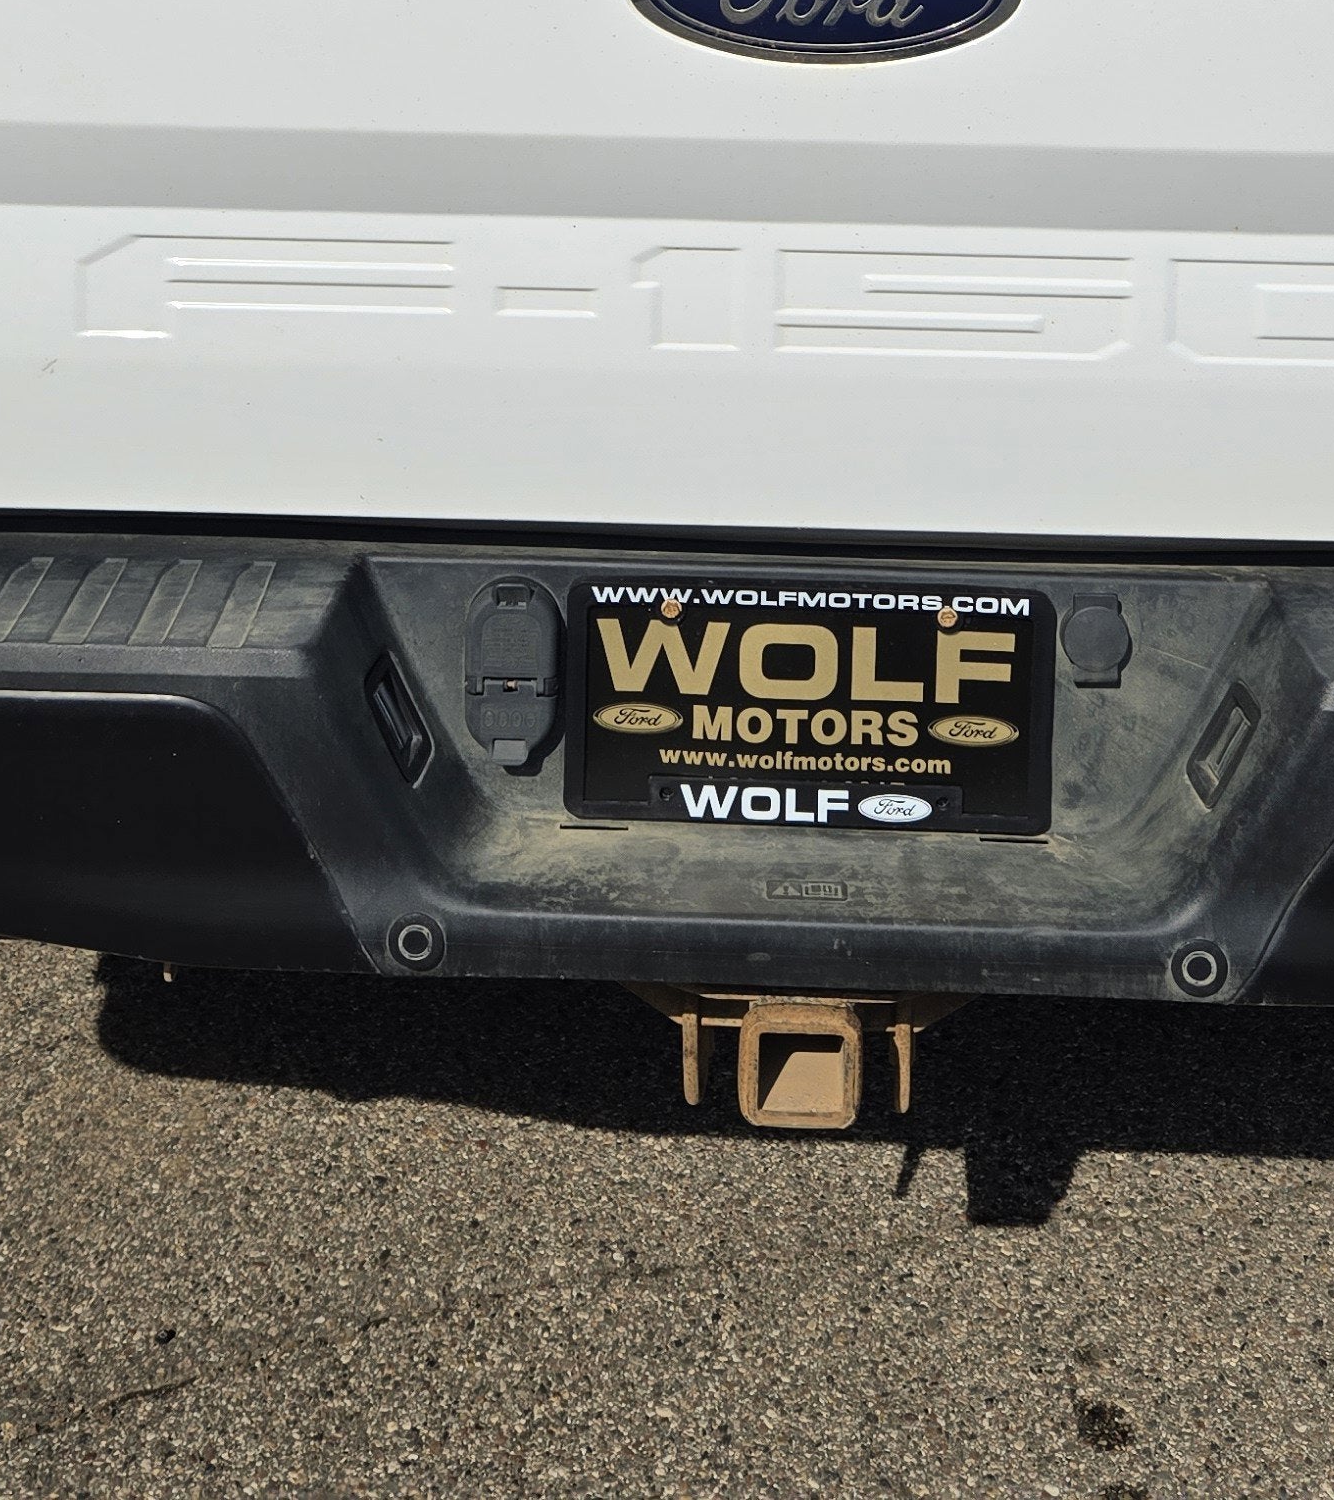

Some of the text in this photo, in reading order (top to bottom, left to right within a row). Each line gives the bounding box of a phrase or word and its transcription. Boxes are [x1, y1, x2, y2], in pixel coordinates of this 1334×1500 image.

[591, 586, 1030, 616] WWW.WOLFMOTORS.COM
[596, 618, 1016, 704] WOLF
[614, 708, 662, 727] Ford
[692, 704, 919, 746] MOTORS
[949, 720, 998, 739] Ford
[659, 749, 952, 774] www.wolfmotors.com
[680, 783, 849, 823] WOLF
[873, 798, 916, 817] Ford
